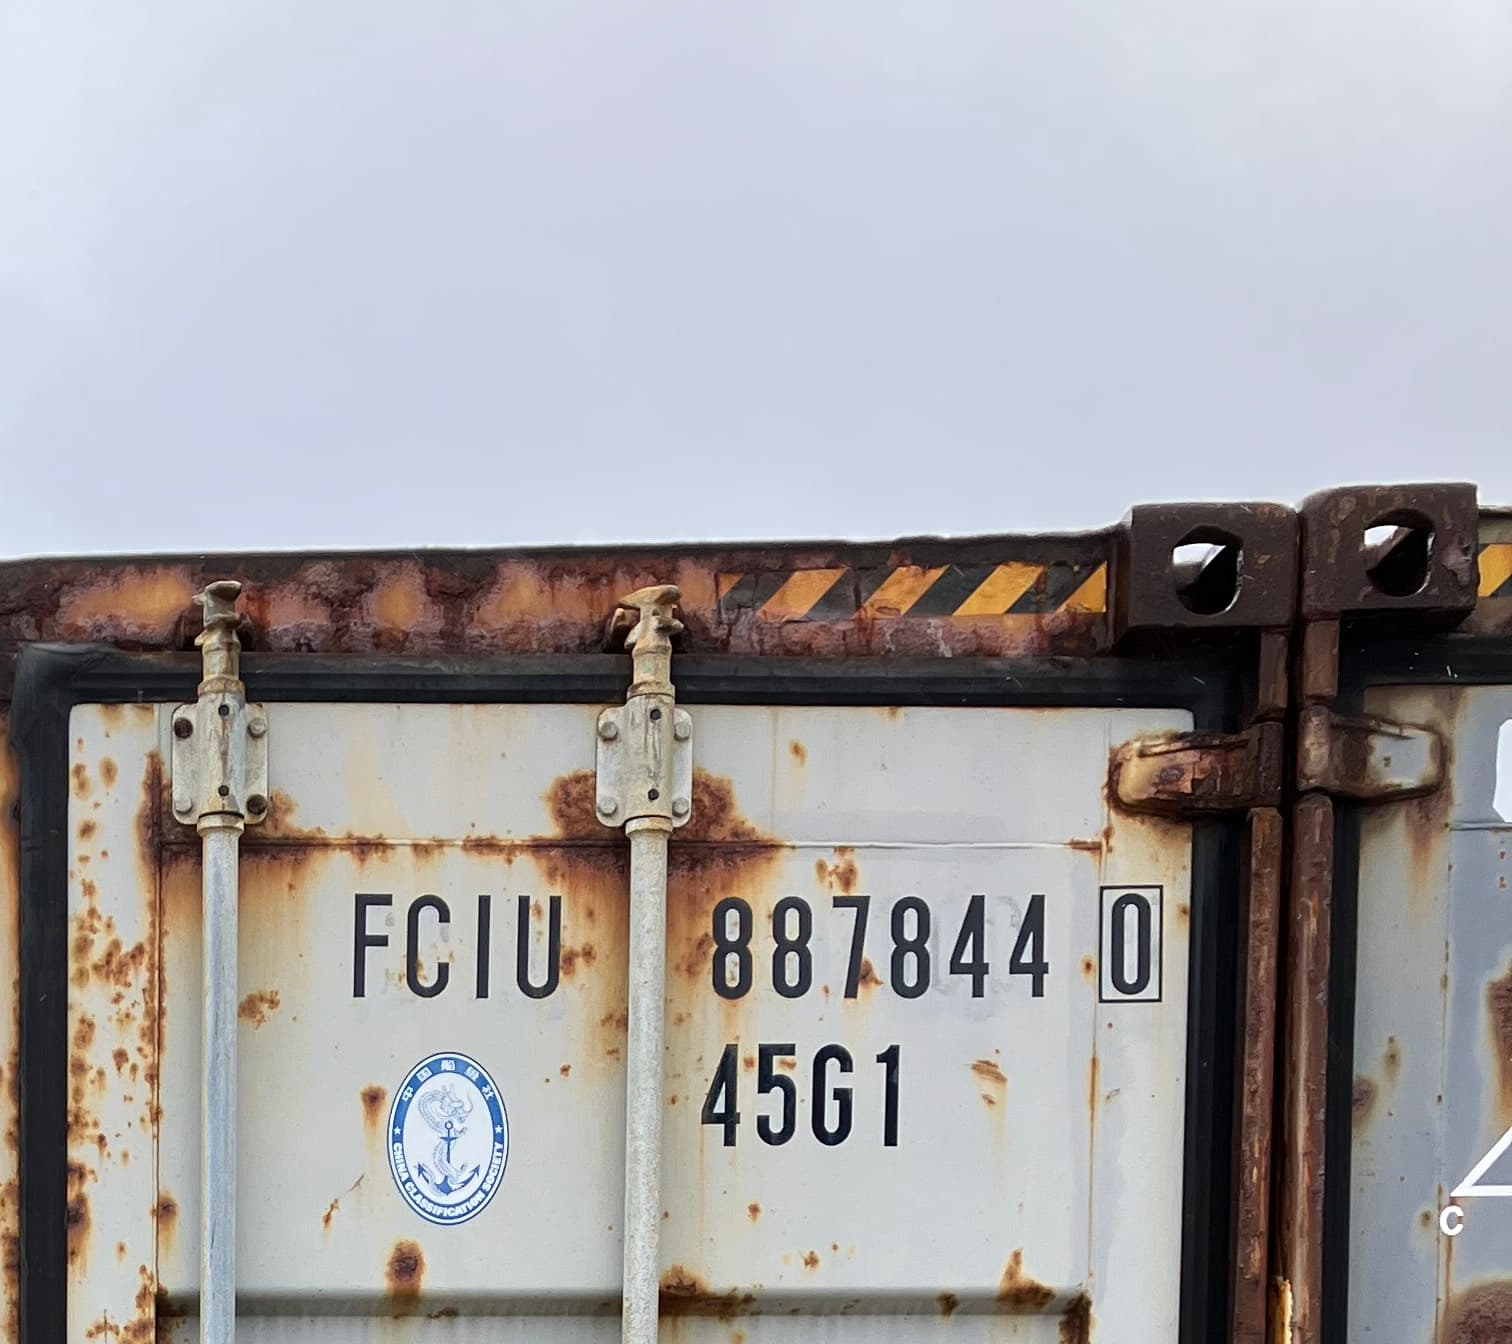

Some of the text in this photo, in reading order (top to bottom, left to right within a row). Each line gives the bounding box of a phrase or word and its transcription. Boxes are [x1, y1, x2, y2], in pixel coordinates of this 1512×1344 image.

[353, 893, 1151, 999] FCIU 887844 0
[701, 1044, 901, 1147] 45G1
[393, 1142, 504, 1216] CHINA CLASSIFICATION SOCIETY
